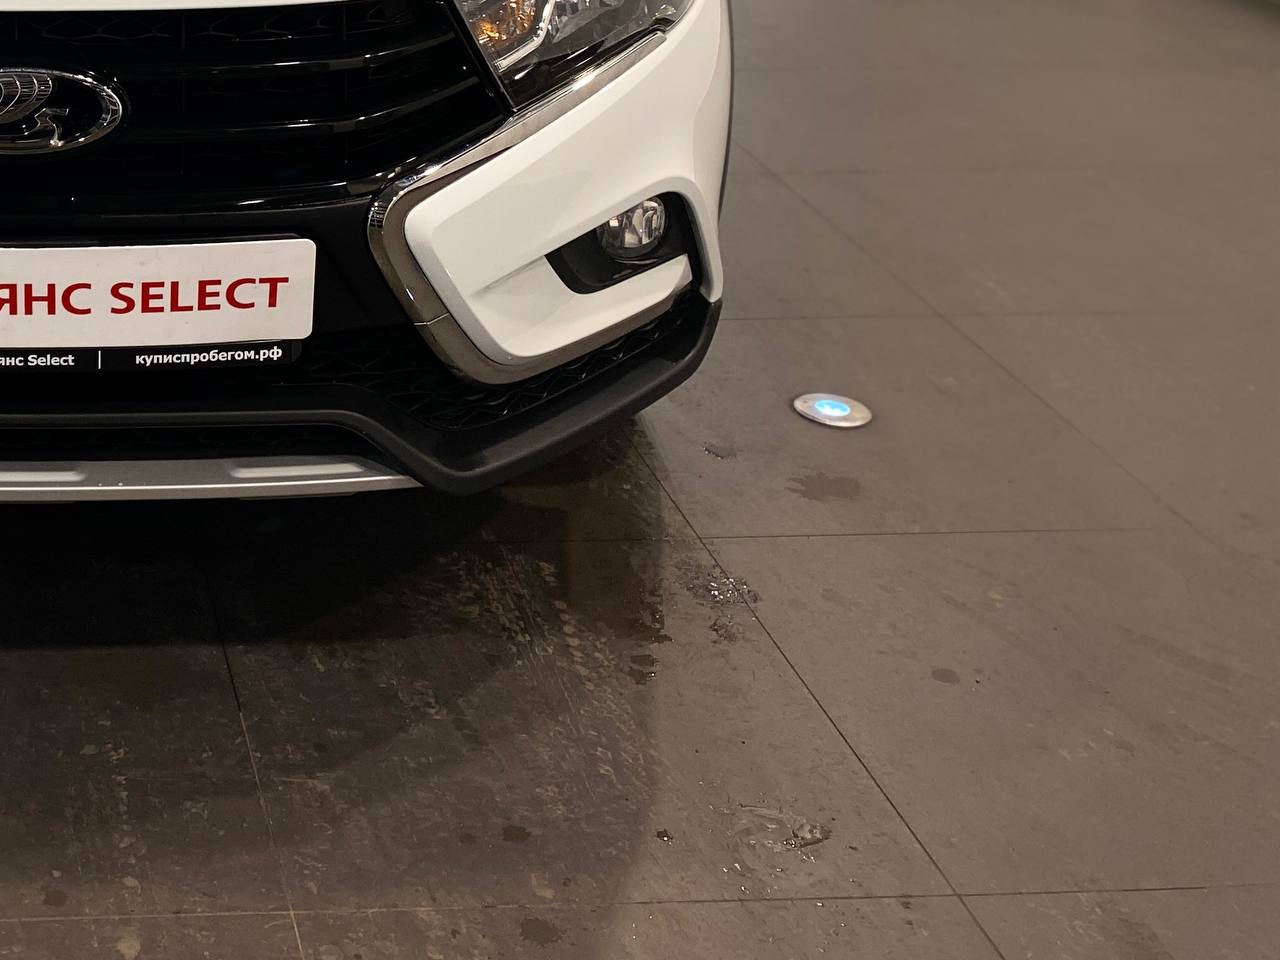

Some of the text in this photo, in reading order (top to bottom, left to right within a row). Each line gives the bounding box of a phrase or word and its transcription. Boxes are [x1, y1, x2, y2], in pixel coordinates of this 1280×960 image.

[110, 276, 289, 315] SELECT
[27, 353, 75, 367] Select
[135, 345, 283, 367] куписпробегом.рф
